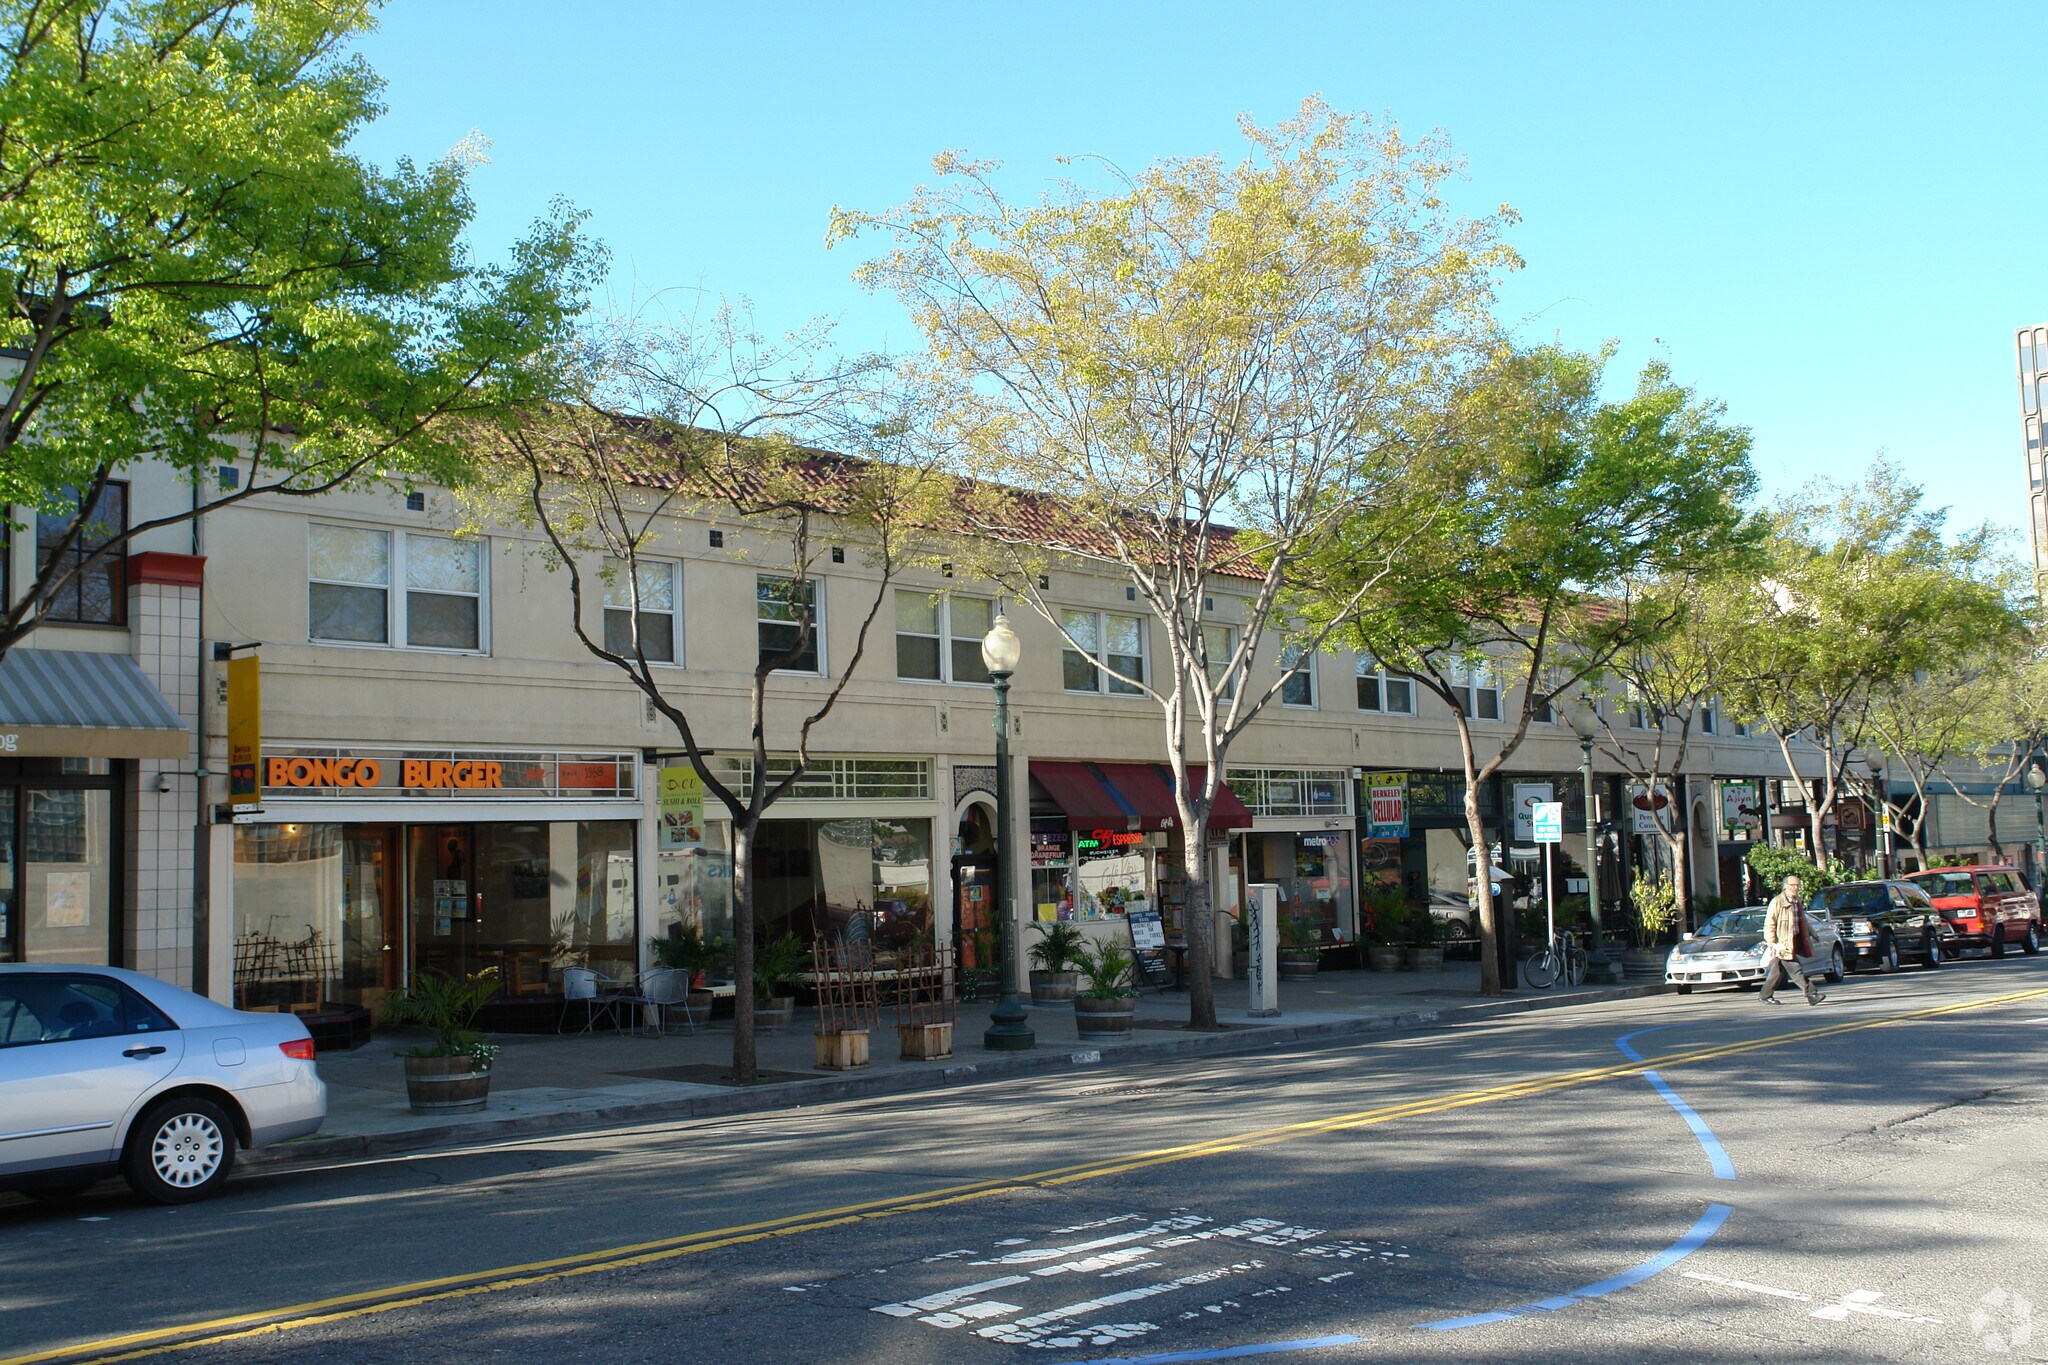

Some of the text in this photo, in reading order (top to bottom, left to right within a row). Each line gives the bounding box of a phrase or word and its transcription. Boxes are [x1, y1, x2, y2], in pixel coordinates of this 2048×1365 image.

[268, 757, 504, 788] BONGO BURGER
[584, 767, 604, 778] 1968
[1373, 789, 1401, 798] BERKELEY
[663, 798, 680, 806] SUSHI
[686, 797, 701, 805] ROLL
[1726, 794, 1752, 804] Ajiya
[1373, 800, 1403, 822] CELLULAR
[1078, 839, 1099, 848] ATM
[1112, 833, 1143, 846] ESPRESSO
